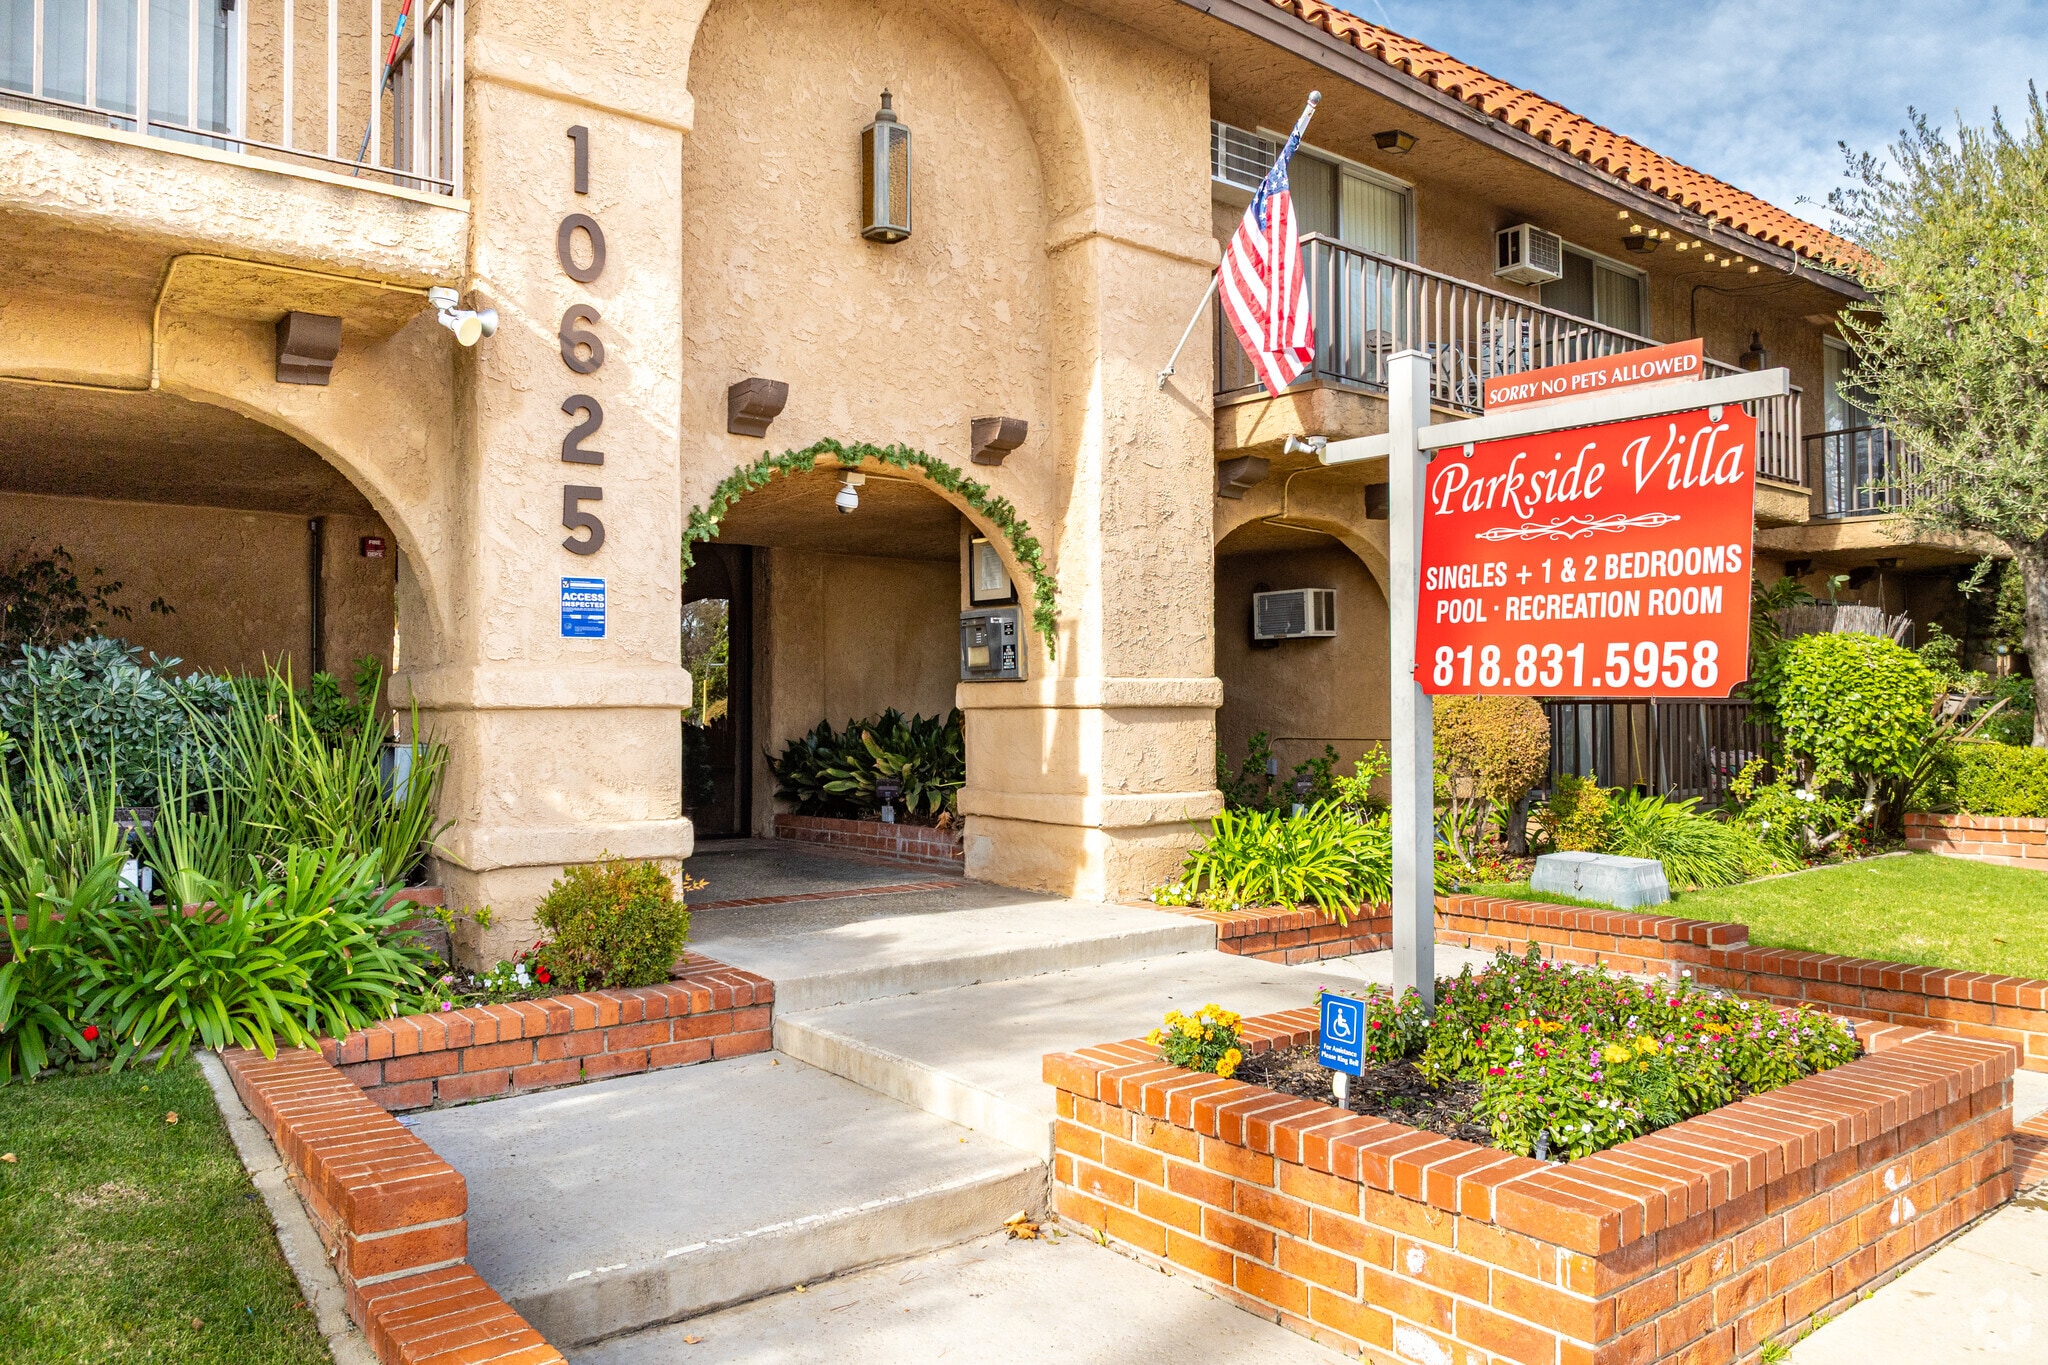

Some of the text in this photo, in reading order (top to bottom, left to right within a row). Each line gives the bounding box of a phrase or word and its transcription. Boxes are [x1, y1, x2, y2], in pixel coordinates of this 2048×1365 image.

[556, 124, 606, 556] 10625
[1489, 354, 1698, 404] SORRY NO PETS ALLOWED
[1432, 422, 1745, 520] Parkside Villa
[1426, 543, 1742, 591] SINGLES + 1 & 2 BEDROOMS
[562, 592, 605, 602] ACCESS
[1436, 598, 1488, 624] POOL
[1505, 590, 1641, 622] RECREATION
[1647, 586, 1723, 616] ROOM
[1433, 639, 1719, 688] 818.831.5958
[1321, 1050, 1336, 1060] Please
[1332, 1045, 1357, 1057] Assistance
